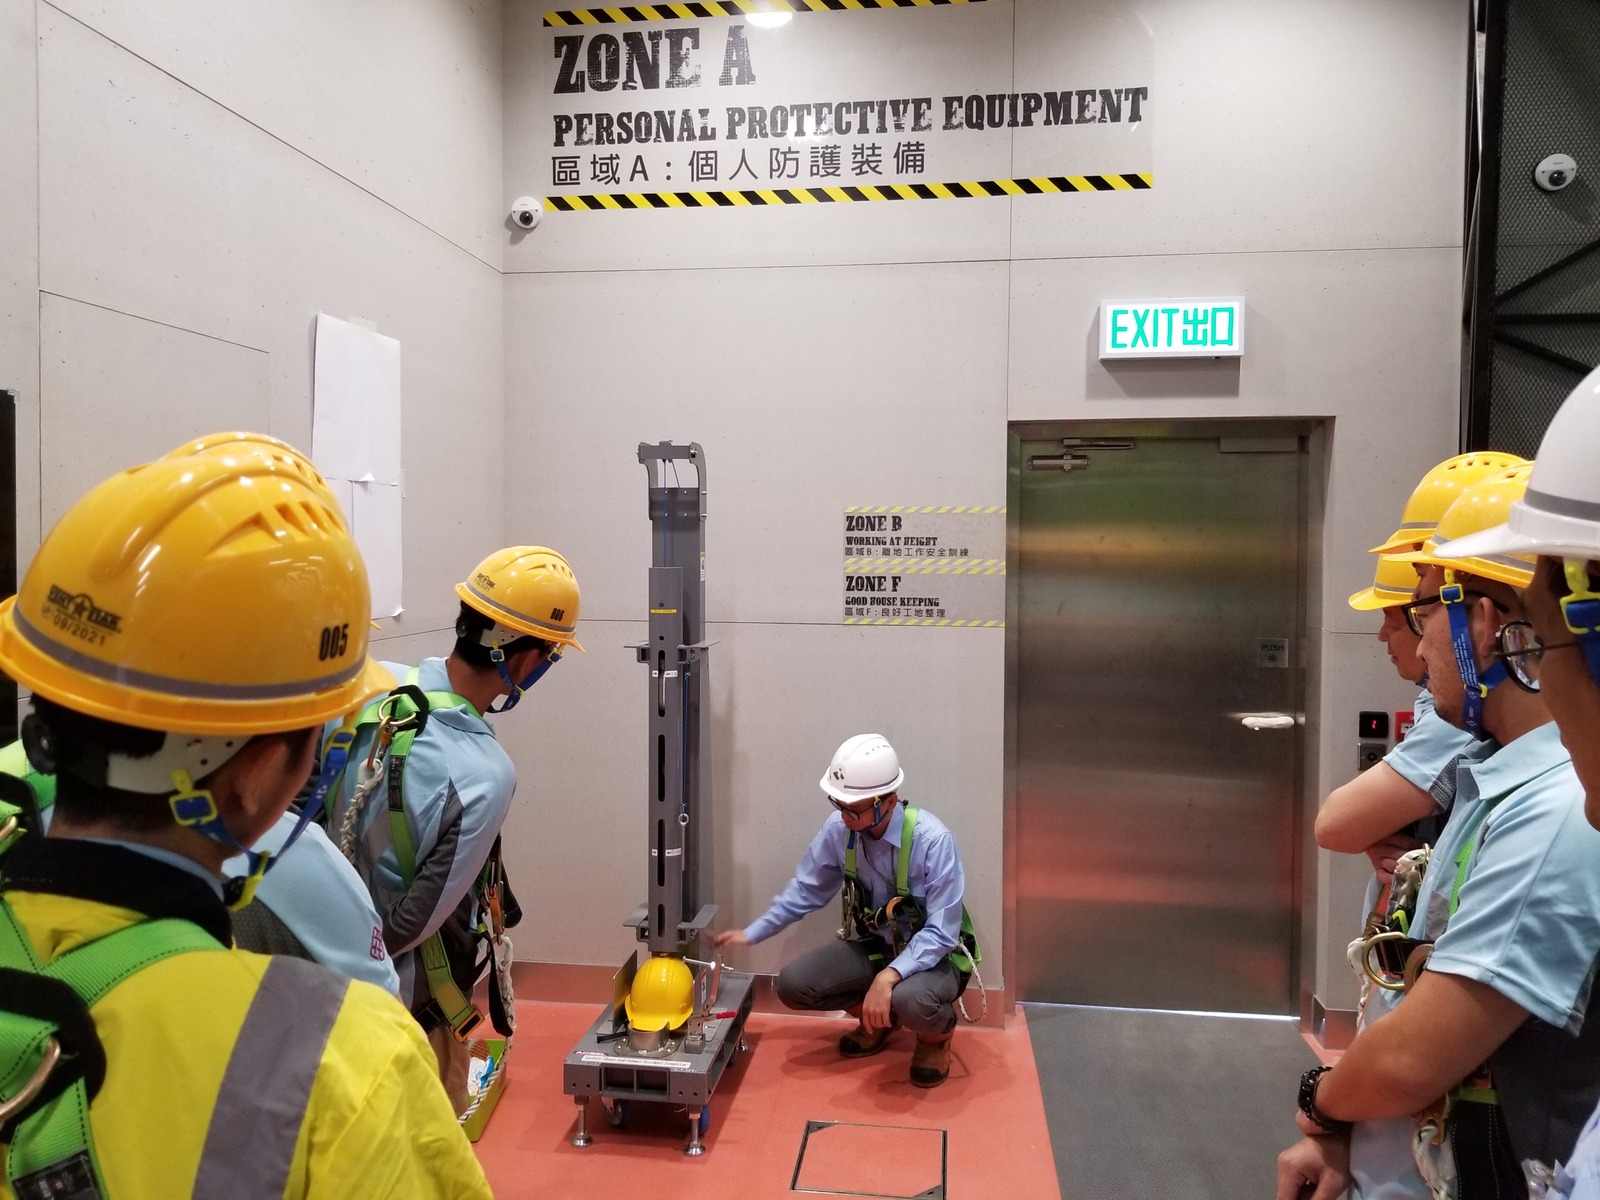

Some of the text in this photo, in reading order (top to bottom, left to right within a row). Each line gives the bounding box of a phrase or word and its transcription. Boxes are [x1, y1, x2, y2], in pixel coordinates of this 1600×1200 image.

[553, 25, 756, 95] ZONE A
[553, 86, 1148, 147] PERSONAL PROTECTIVE EQUIPMENT
[1111, 309, 1180, 348] EXIT
[1182, 307, 1234, 346] 出口
[846, 516, 903, 532] ZONE B
[846, 537, 938, 546] WORKING AT HEIGHT
[846, 576, 902, 592] ZONE F
[846, 597, 940, 607] GOOD HOUSE KEEPING
[318, 623, 349, 662] 005
[1261, 643, 1284, 651] PUSH
